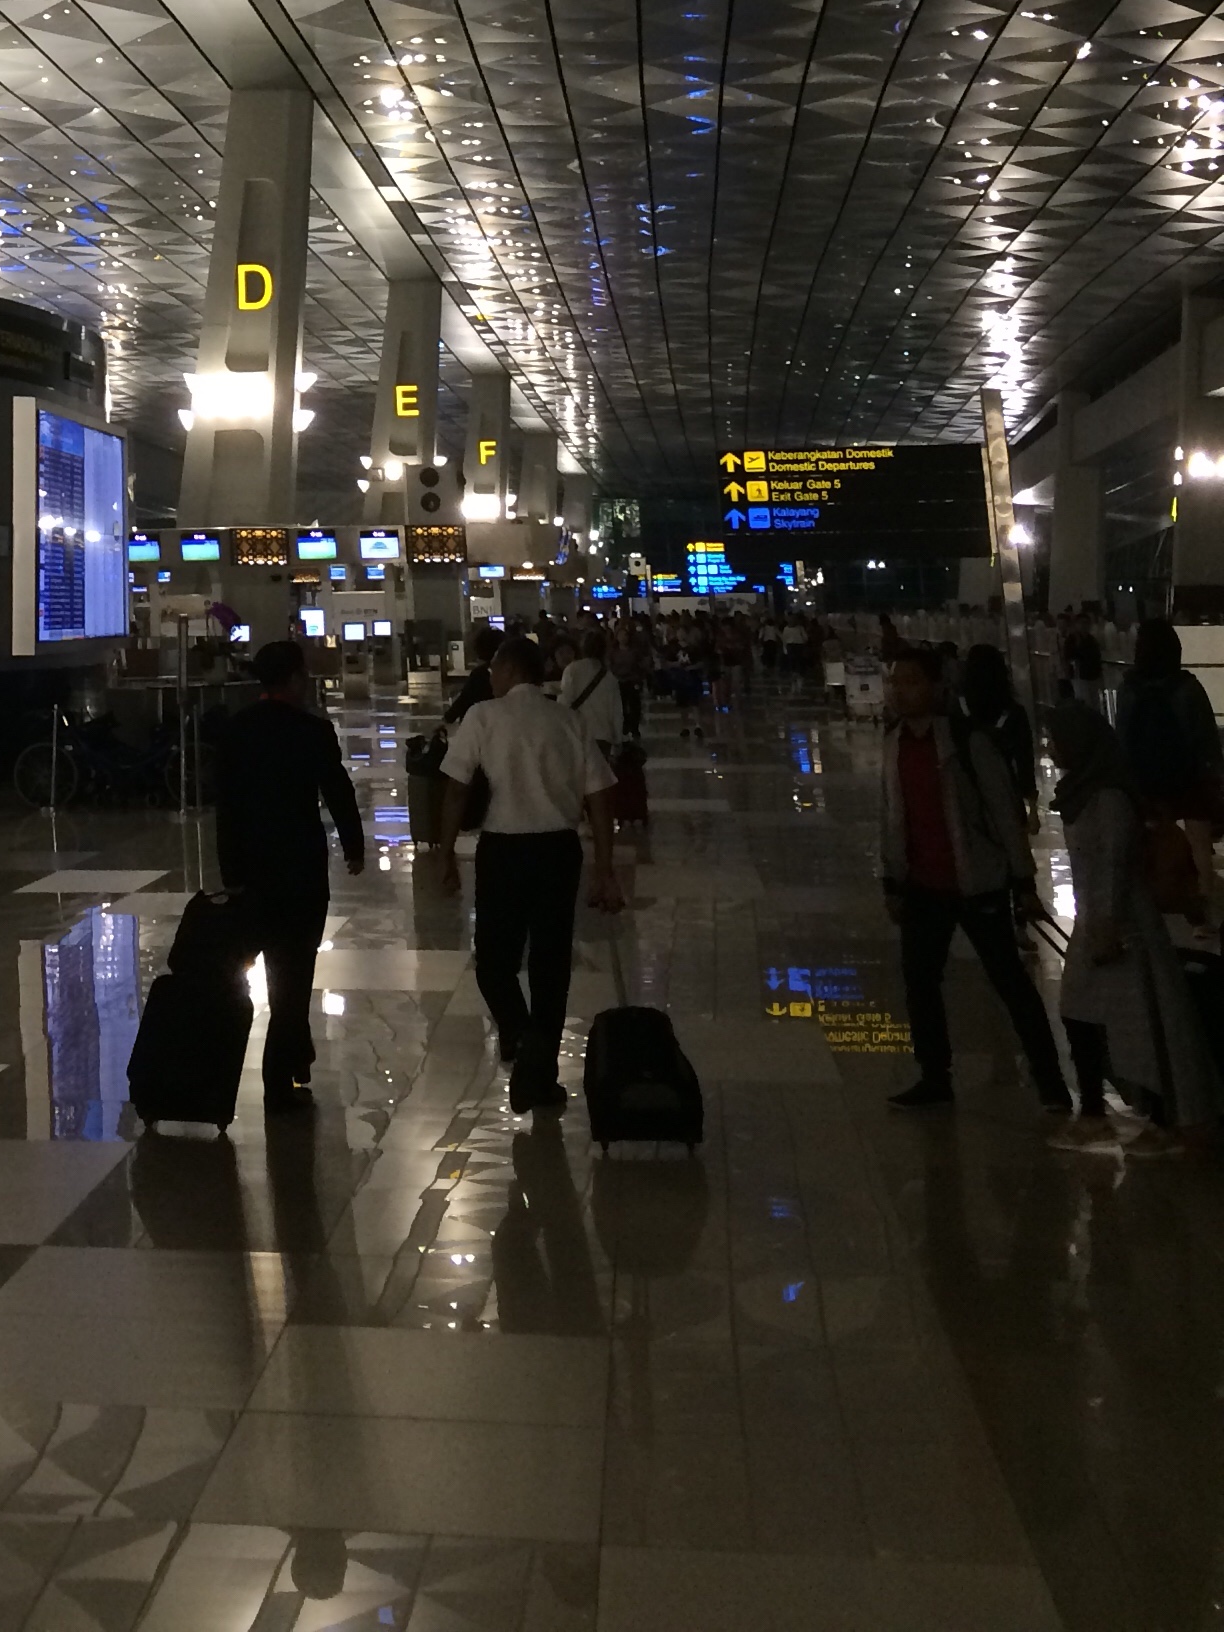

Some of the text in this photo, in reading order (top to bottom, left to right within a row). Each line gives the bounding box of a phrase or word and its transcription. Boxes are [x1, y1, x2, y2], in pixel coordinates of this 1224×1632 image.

[238, 264, 272, 309] D
[396, 386, 419, 416] E
[480, 441, 496, 465] F
[768, 448, 894, 462] Keberangkatan Domestik
[769, 461, 875, 472] Domestic Departures
[770, 480, 841, 490] Keluar Gate 5
[772, 491, 828, 502] Exit Gate 5
[774, 520, 815, 530] Skytrain
